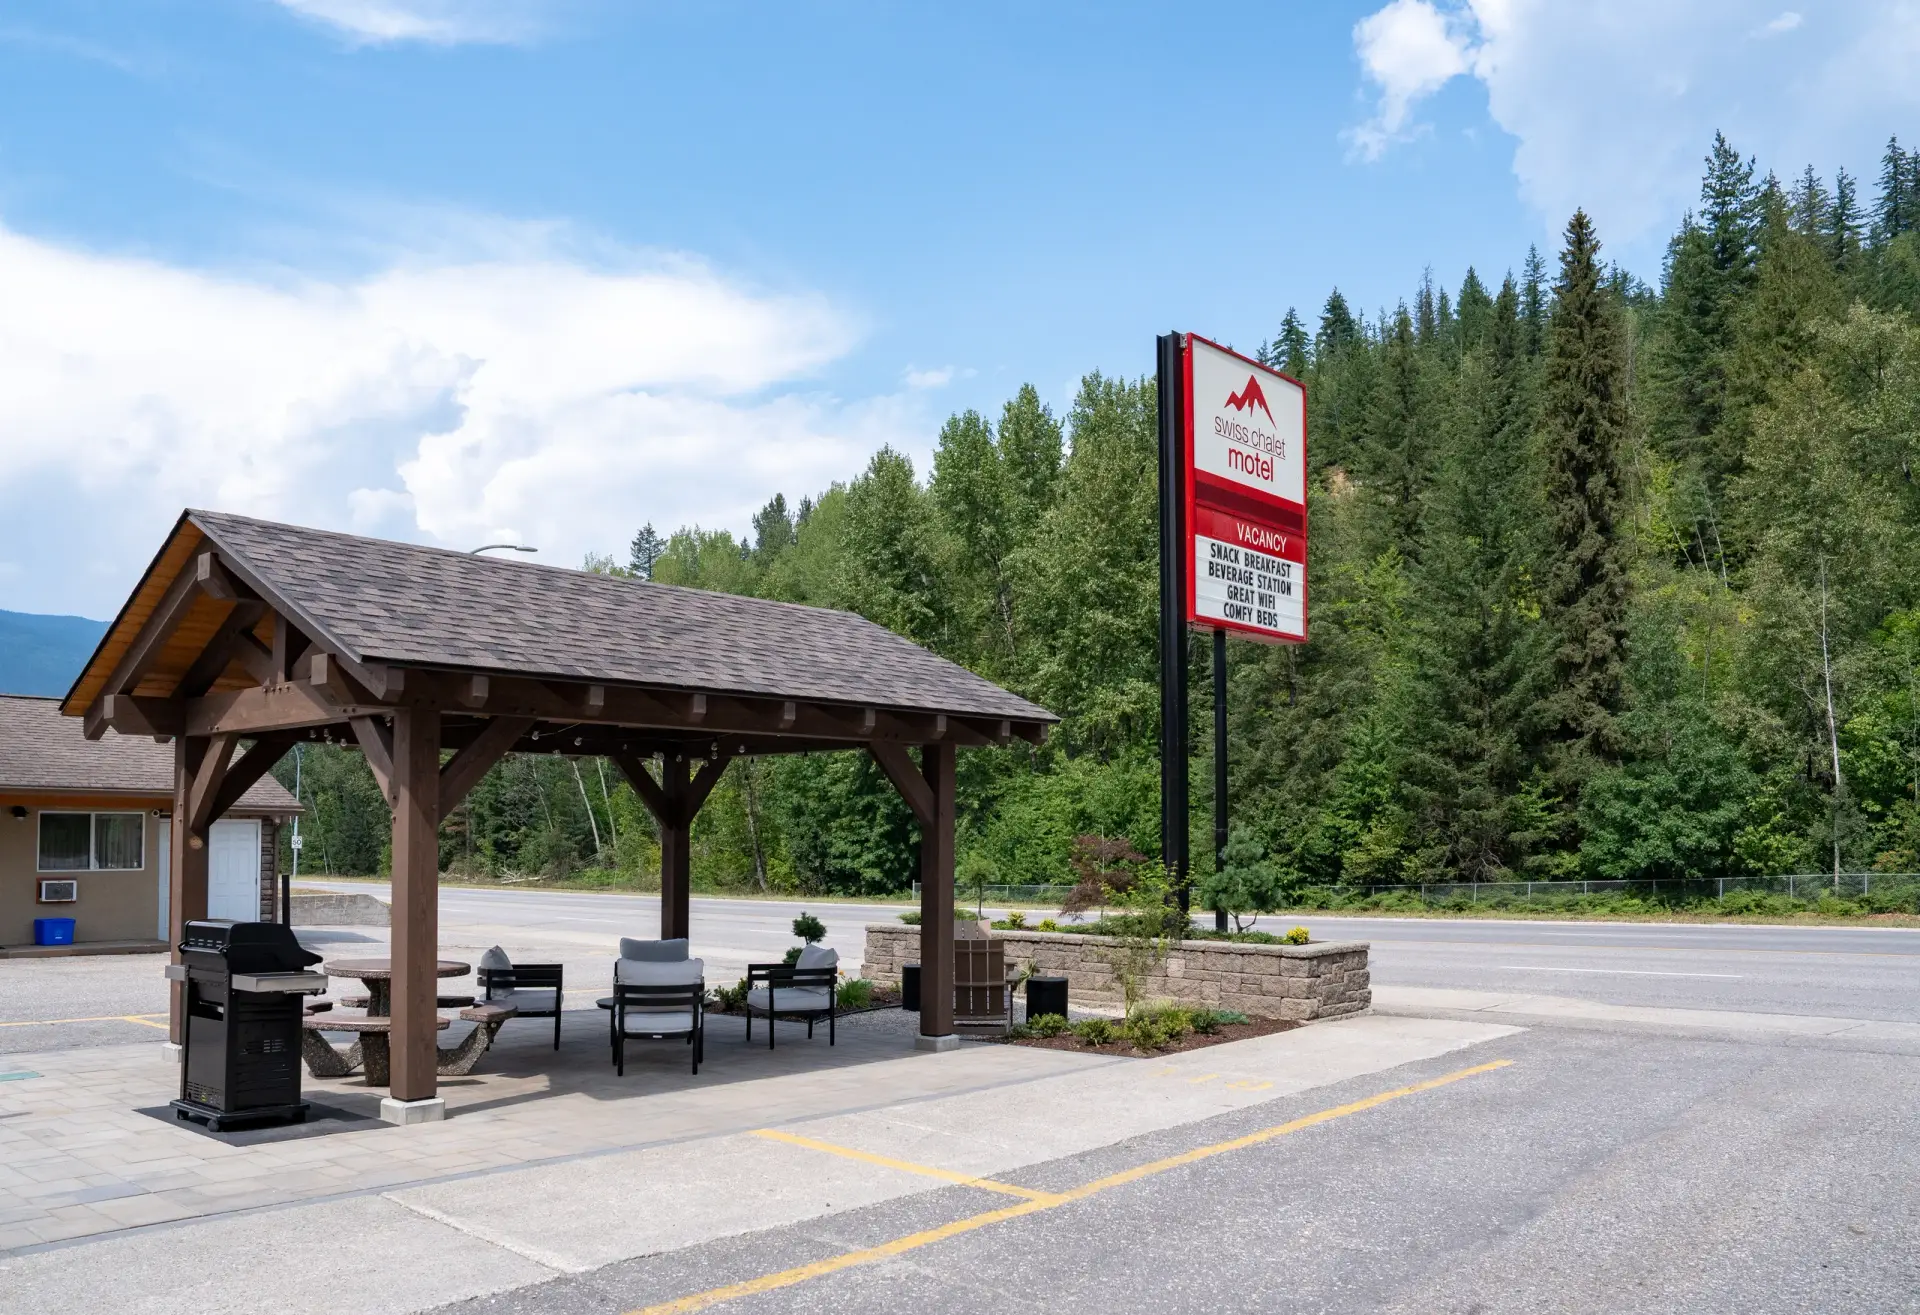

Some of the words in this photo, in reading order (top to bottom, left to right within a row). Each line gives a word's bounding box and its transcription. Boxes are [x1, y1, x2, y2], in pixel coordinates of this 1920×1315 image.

[1214, 416, 1249, 443] swiss
[1251, 428, 1286, 458] chalet
[1228, 447, 1273, 482] motel
[1237, 522, 1287, 553] VACANCY
[1210, 542, 1240, 565] SNACK
[1244, 552, 1291, 579] BREAKFAST
[1209, 561, 1253, 586] BEVERAGE
[1257, 574, 1291, 596] STATION
[1224, 602, 1253, 622] COMFY
[1257, 610, 1278, 628] BEDS
[1227, 585, 1255, 605] GREAT
[1258, 592, 1276, 610] WIFI
